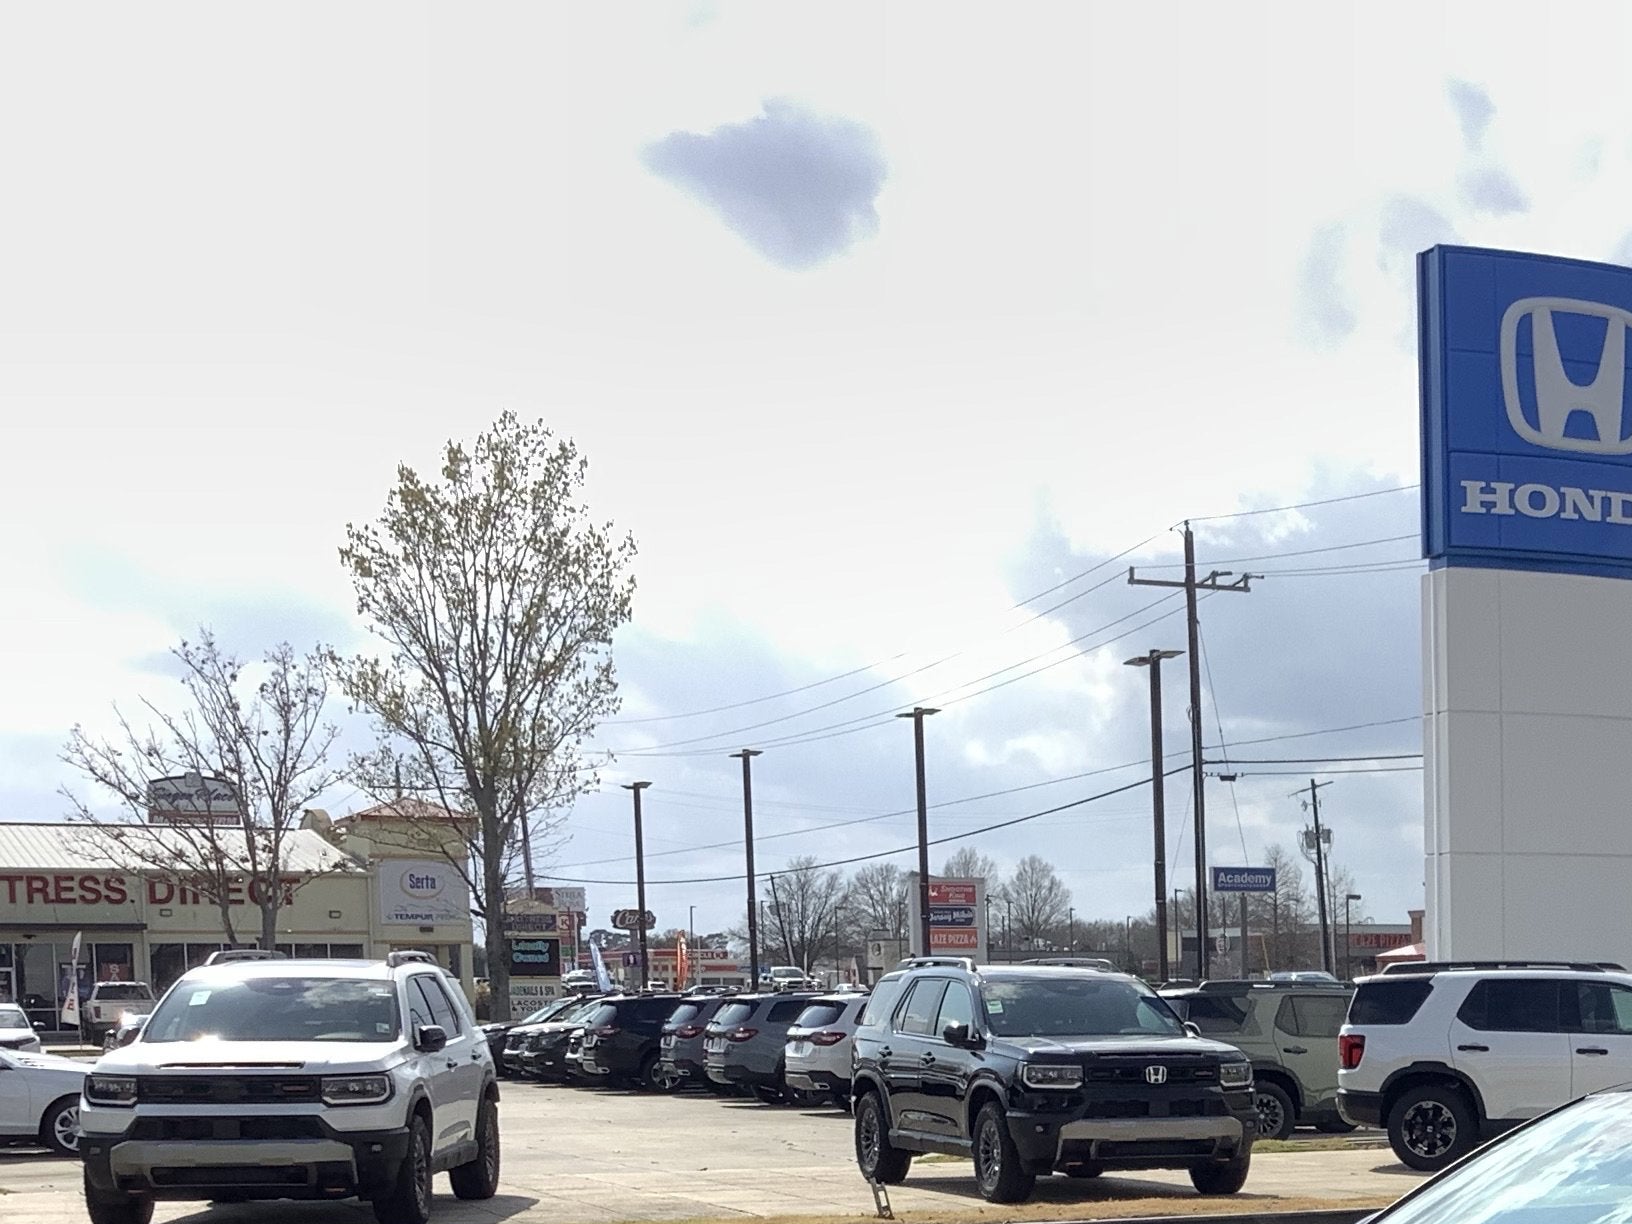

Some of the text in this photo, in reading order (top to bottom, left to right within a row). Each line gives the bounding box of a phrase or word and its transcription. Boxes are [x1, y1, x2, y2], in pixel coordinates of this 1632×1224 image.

[409, 873, 436, 889] Serta
[1218, 872, 1272, 887] Academy
[930, 934, 968, 945] LAZE PIZZA
